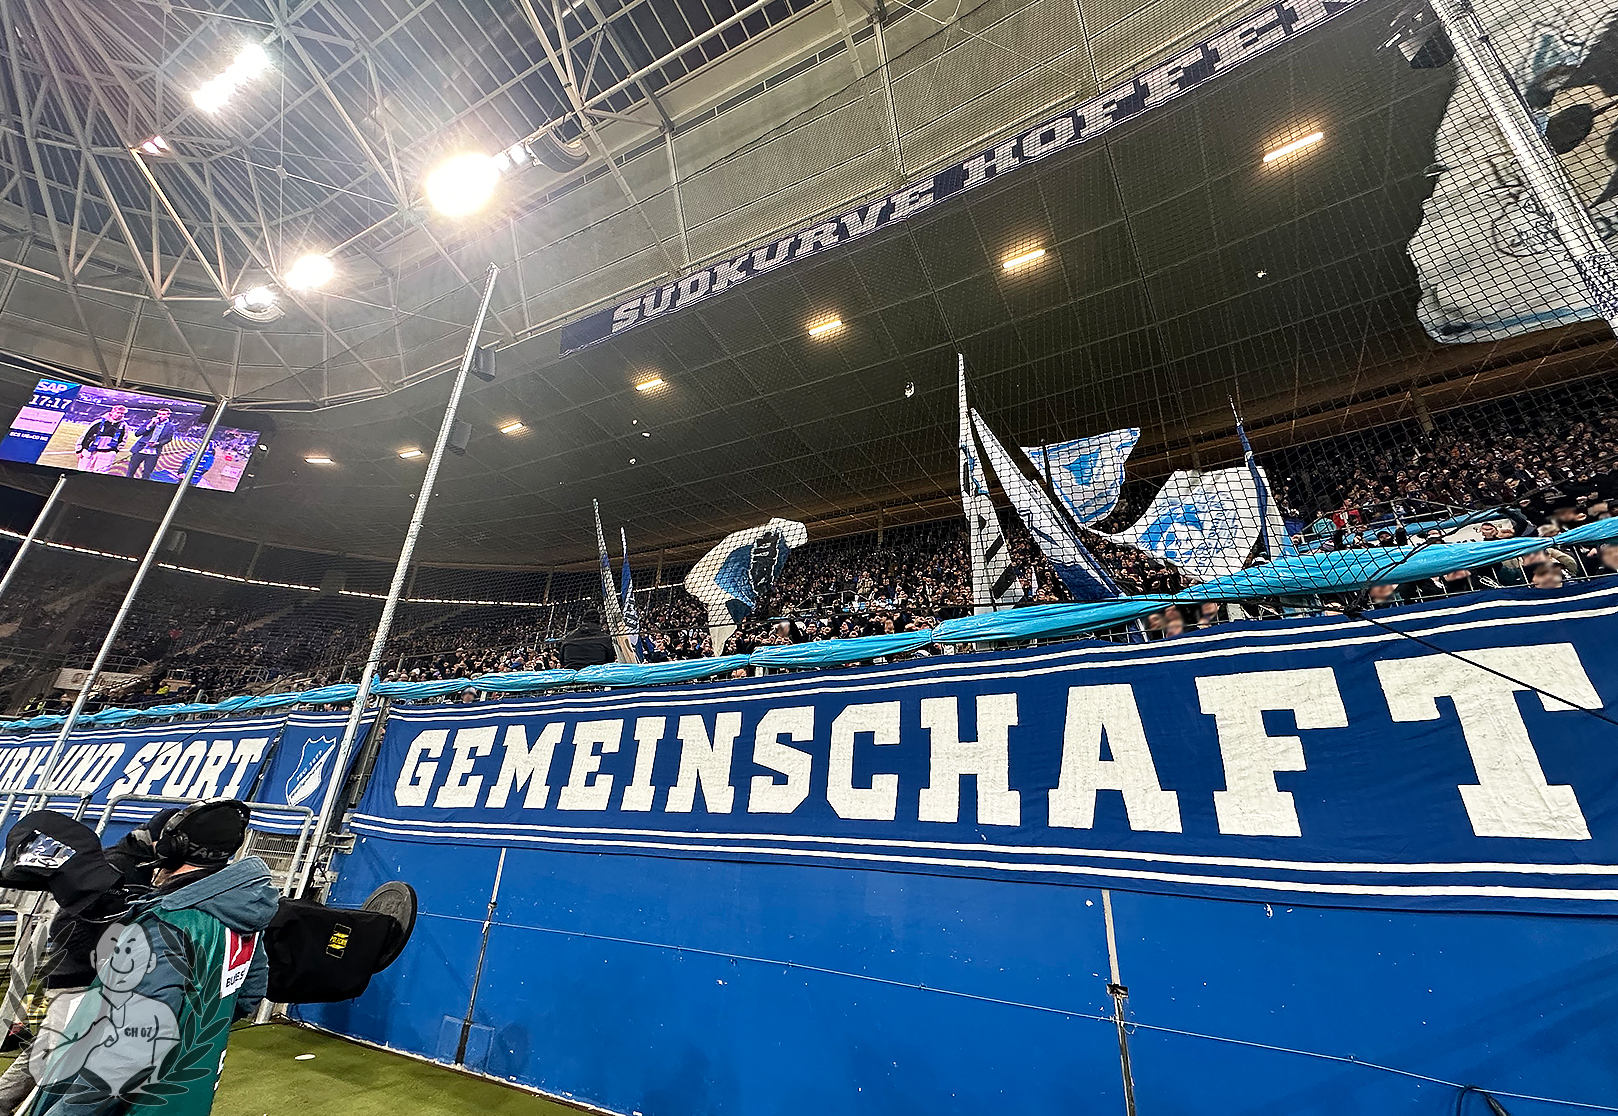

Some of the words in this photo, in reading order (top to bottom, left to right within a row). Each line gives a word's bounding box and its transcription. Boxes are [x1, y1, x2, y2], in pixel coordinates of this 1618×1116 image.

[28, 394, 72, 409] 17:17
[36, 381, 67, 394] SAP
[394, 641, 1604, 841] GEMEINSCHAFT
[45, 742, 127, 794] UND
[106, 737, 270, 800] SPORT
